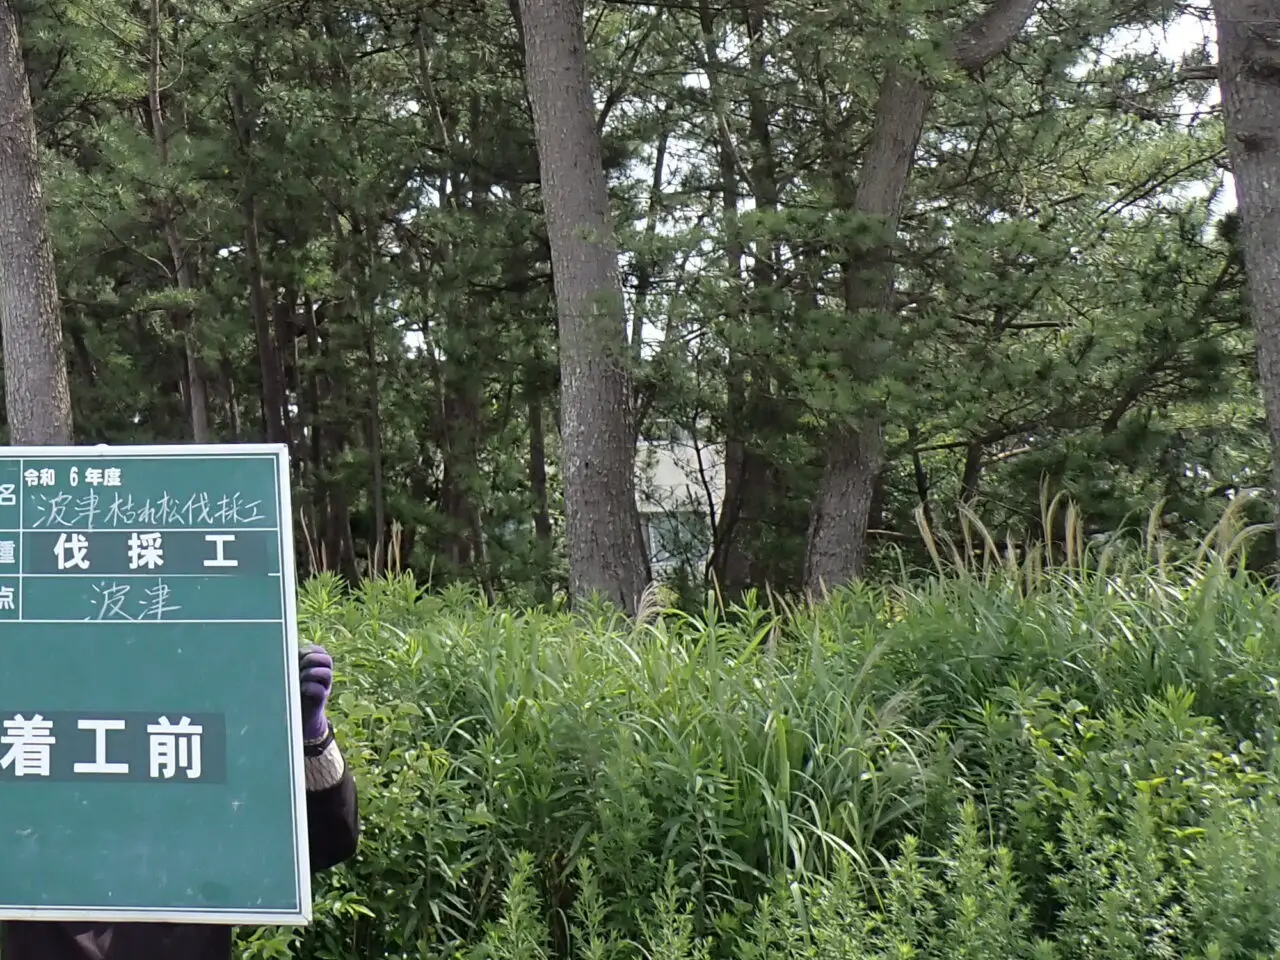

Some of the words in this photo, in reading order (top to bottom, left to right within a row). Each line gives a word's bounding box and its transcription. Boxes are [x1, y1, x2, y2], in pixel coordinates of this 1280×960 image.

[54, 532, 238, 570] 伐採工
[87, 578, 183, 621] 波津
[0, 713, 203, 779] 着工前
